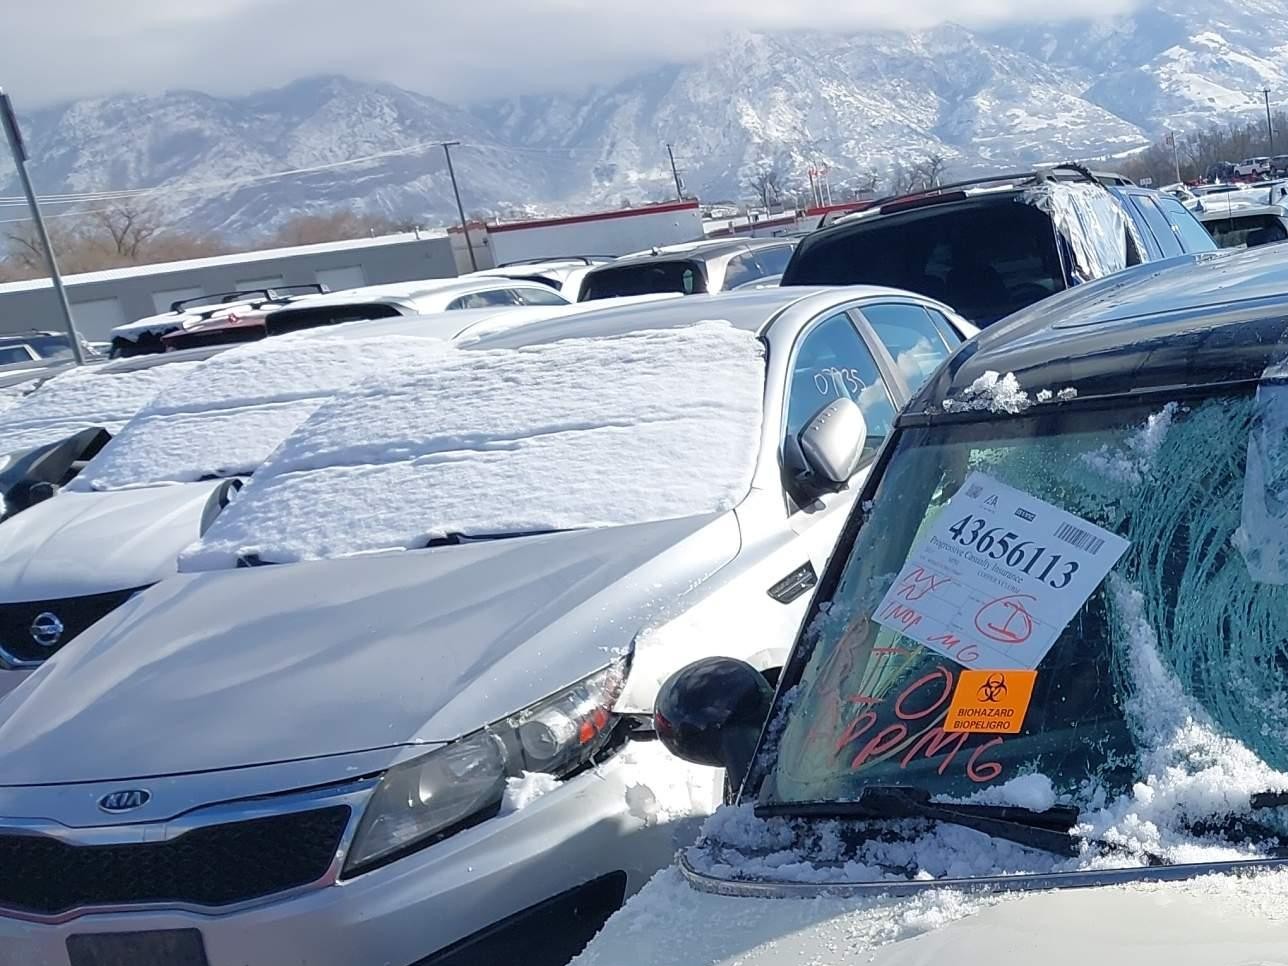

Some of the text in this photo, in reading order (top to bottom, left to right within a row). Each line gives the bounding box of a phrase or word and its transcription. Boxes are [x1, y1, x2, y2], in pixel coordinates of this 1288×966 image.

[948, 513, 1080, 589] 43656113
[990, 562, 1025, 585] Insurance
[957, 707, 1015, 719] BIOHAZARD
[953, 720, 1011, 731] BIOPELIGRO
[105, 791, 142, 808] KIA
